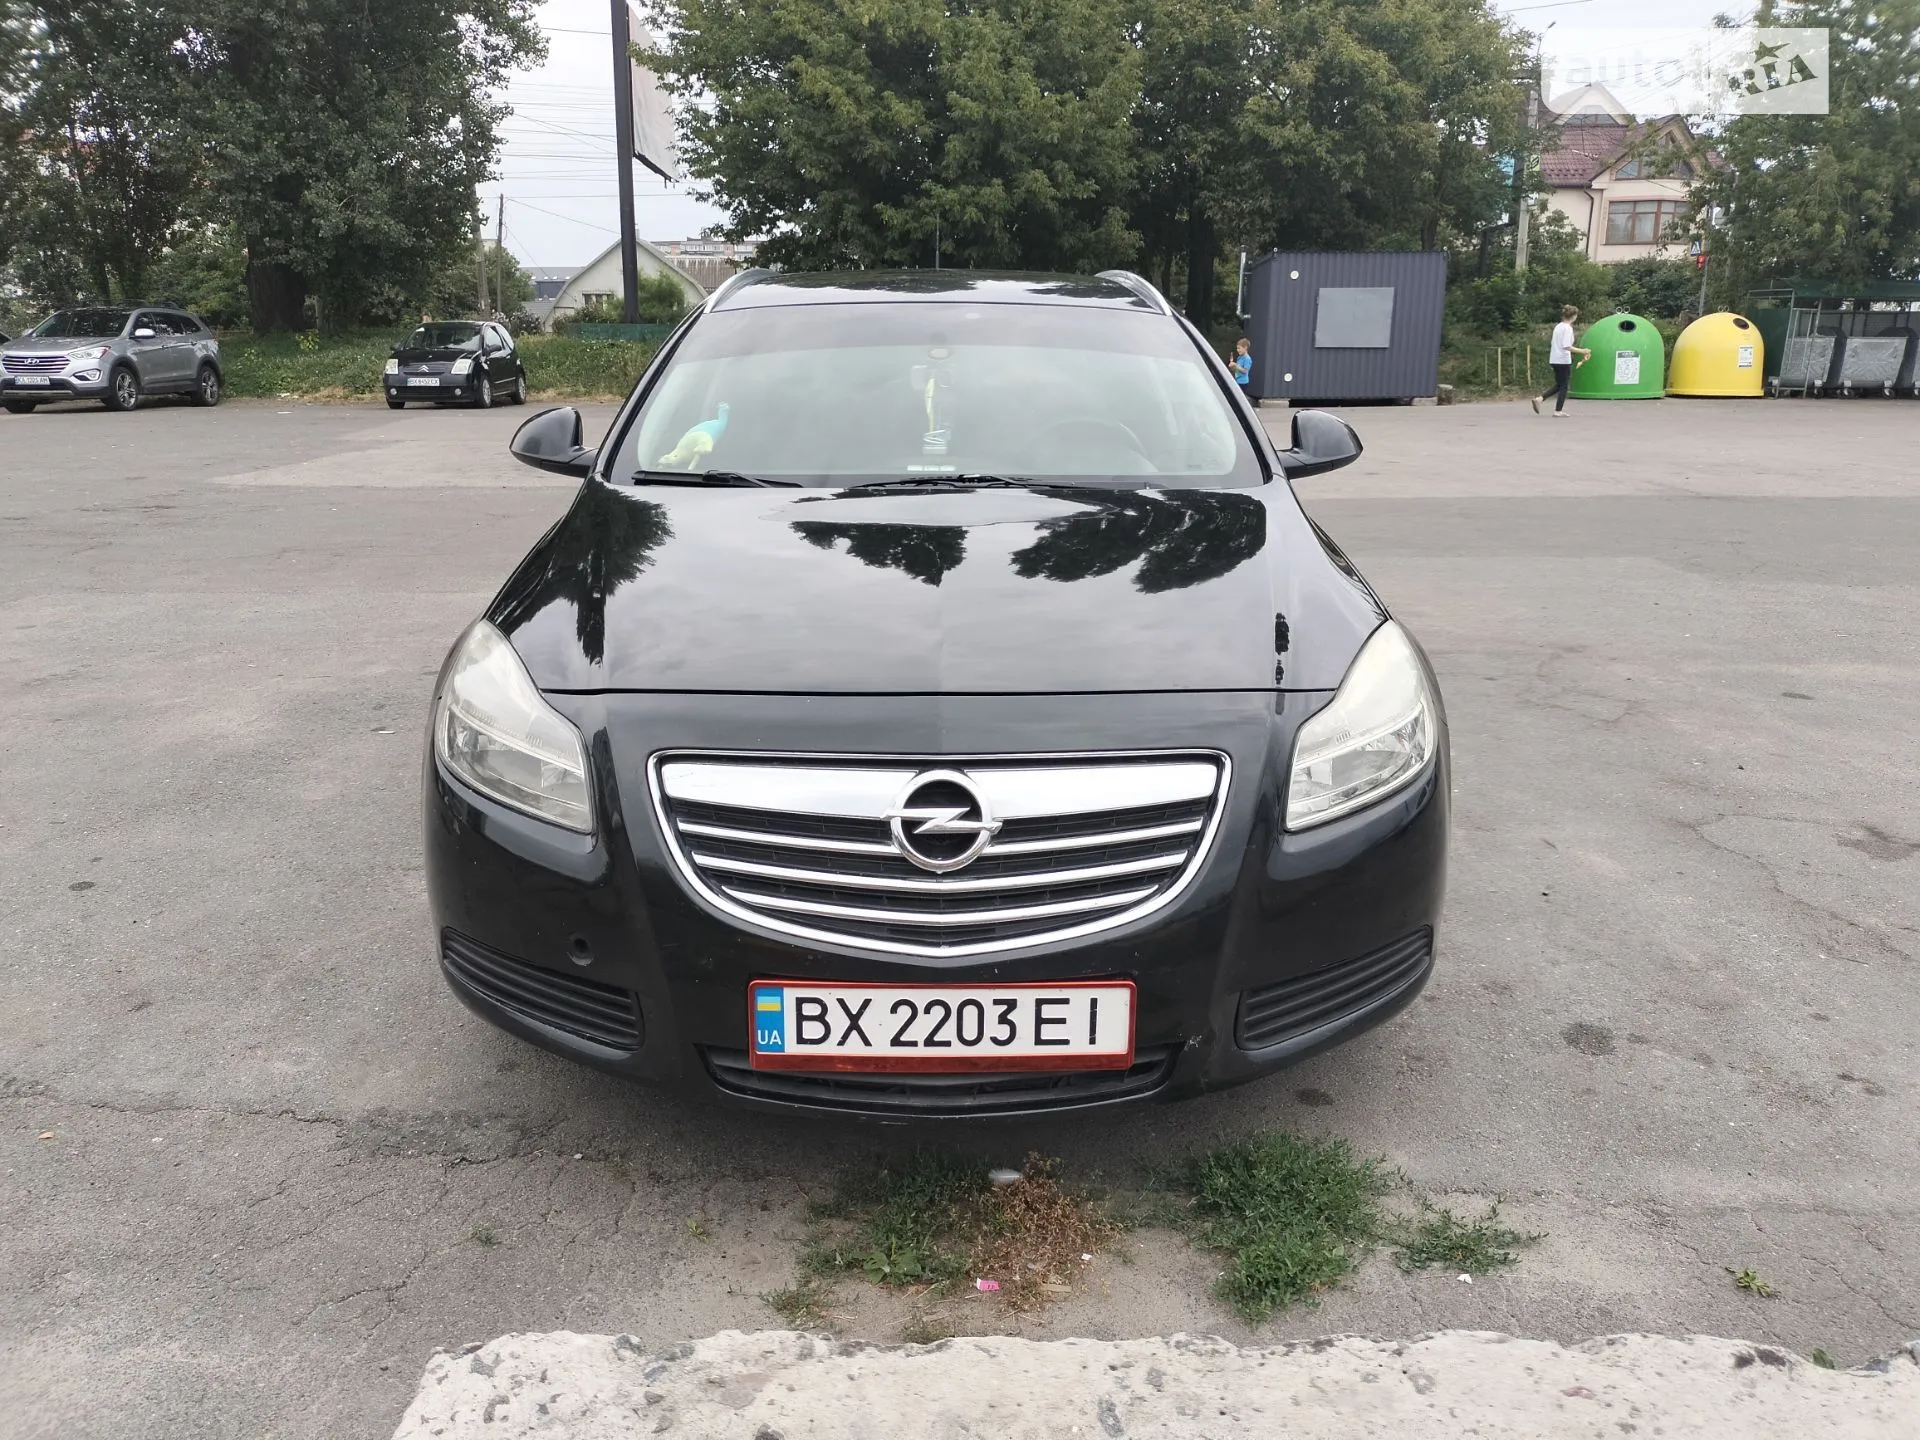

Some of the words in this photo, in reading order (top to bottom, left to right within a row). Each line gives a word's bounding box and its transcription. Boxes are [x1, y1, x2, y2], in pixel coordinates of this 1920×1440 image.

[757, 1029, 782, 1045] UA
[795, 997, 873, 1047] BX
[889, 997, 1017, 1048] 2203
